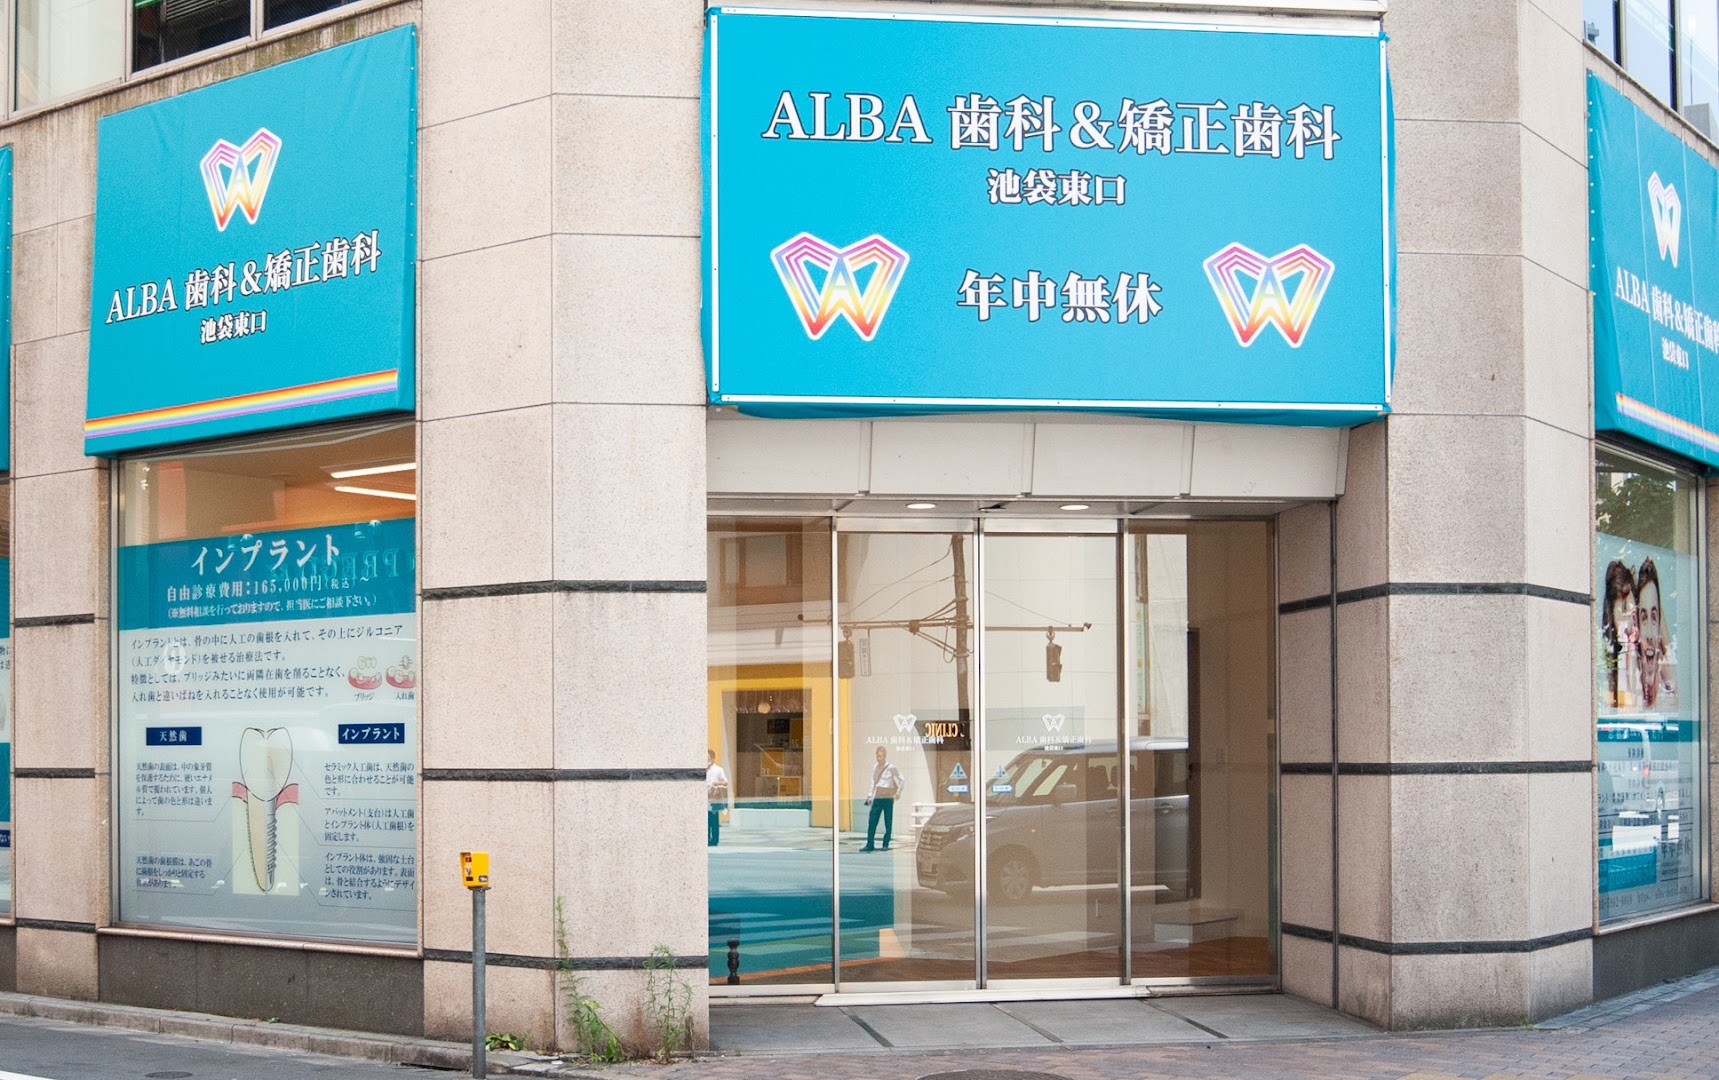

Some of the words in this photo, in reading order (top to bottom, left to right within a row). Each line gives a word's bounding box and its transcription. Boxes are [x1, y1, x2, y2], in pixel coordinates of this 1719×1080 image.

[762, 91, 932, 145] ALBA
[947, 92, 1341, 160] 歯科&矯正歯科
[987, 168, 1127, 206] 池袋東口
[105, 278, 178, 325] ALBA
[957, 269, 1164, 323] 年中無休
[1615, 266, 1650, 314] ALBA
[200, 310, 267, 345] 池袋東口
[190, 533, 340, 577] インプラント
[159, 729, 188, 743] 天然歯
[341, 726, 400, 741] インプラント
